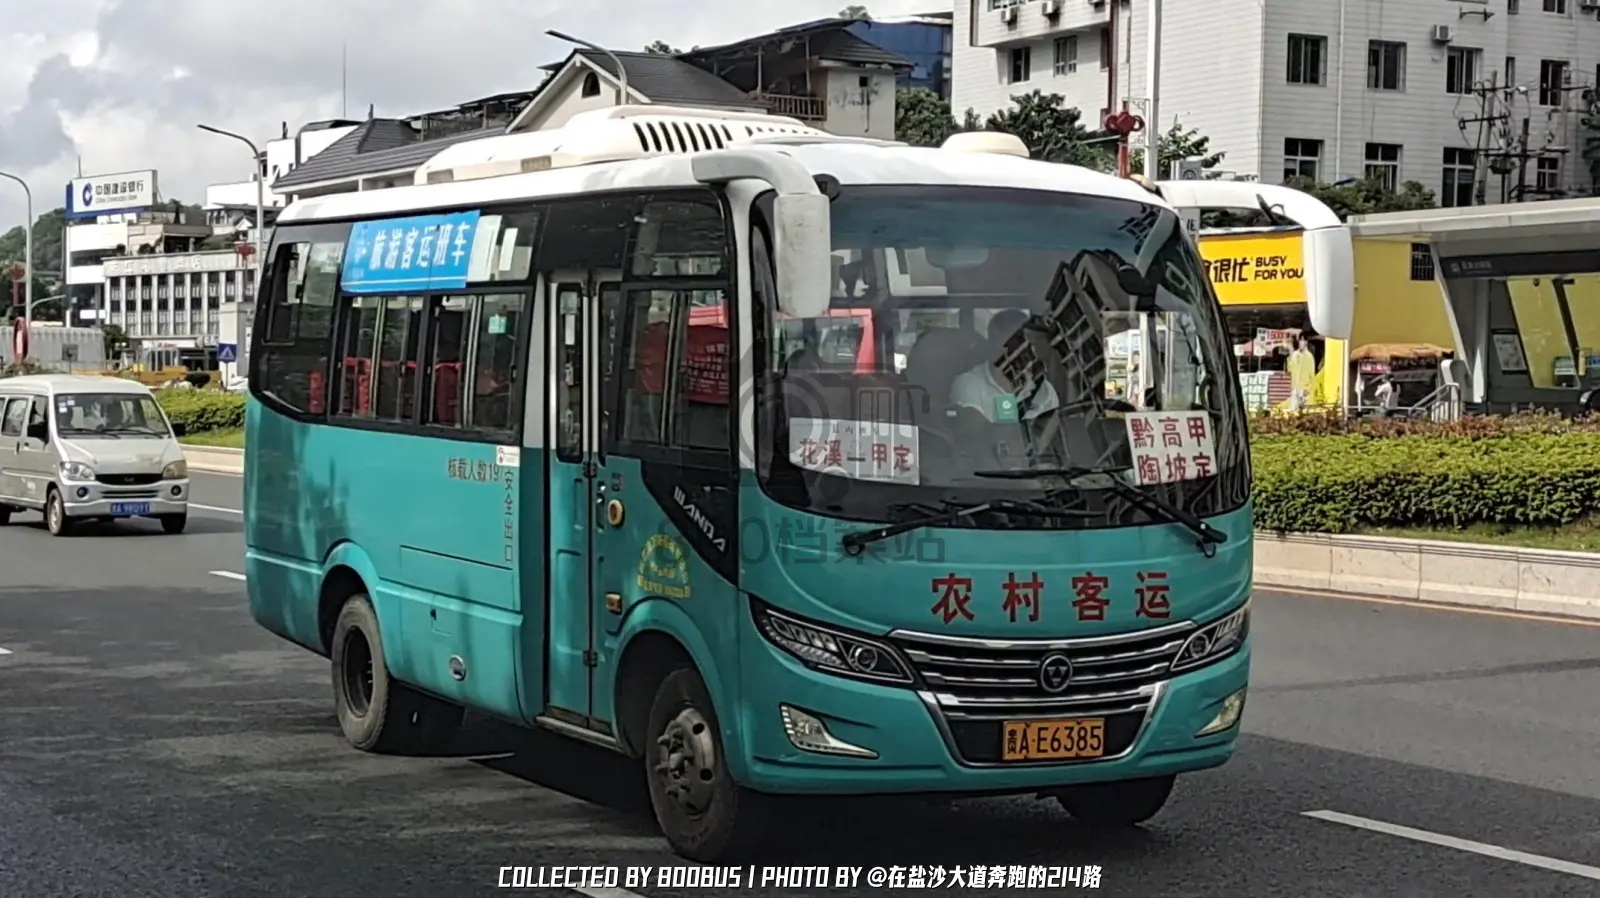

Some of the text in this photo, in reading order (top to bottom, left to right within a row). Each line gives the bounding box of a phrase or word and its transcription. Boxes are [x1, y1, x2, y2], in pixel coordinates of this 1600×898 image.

[95, 180, 144, 195] 中国建设银行
[1255, 256, 1287, 267] BUSY
[1255, 267, 1304, 280] FOR YOU
[504, 468, 514, 563] 安全出口
[674, 486, 726, 552] WANDA
[930, 571, 1172, 624] 农村客运
